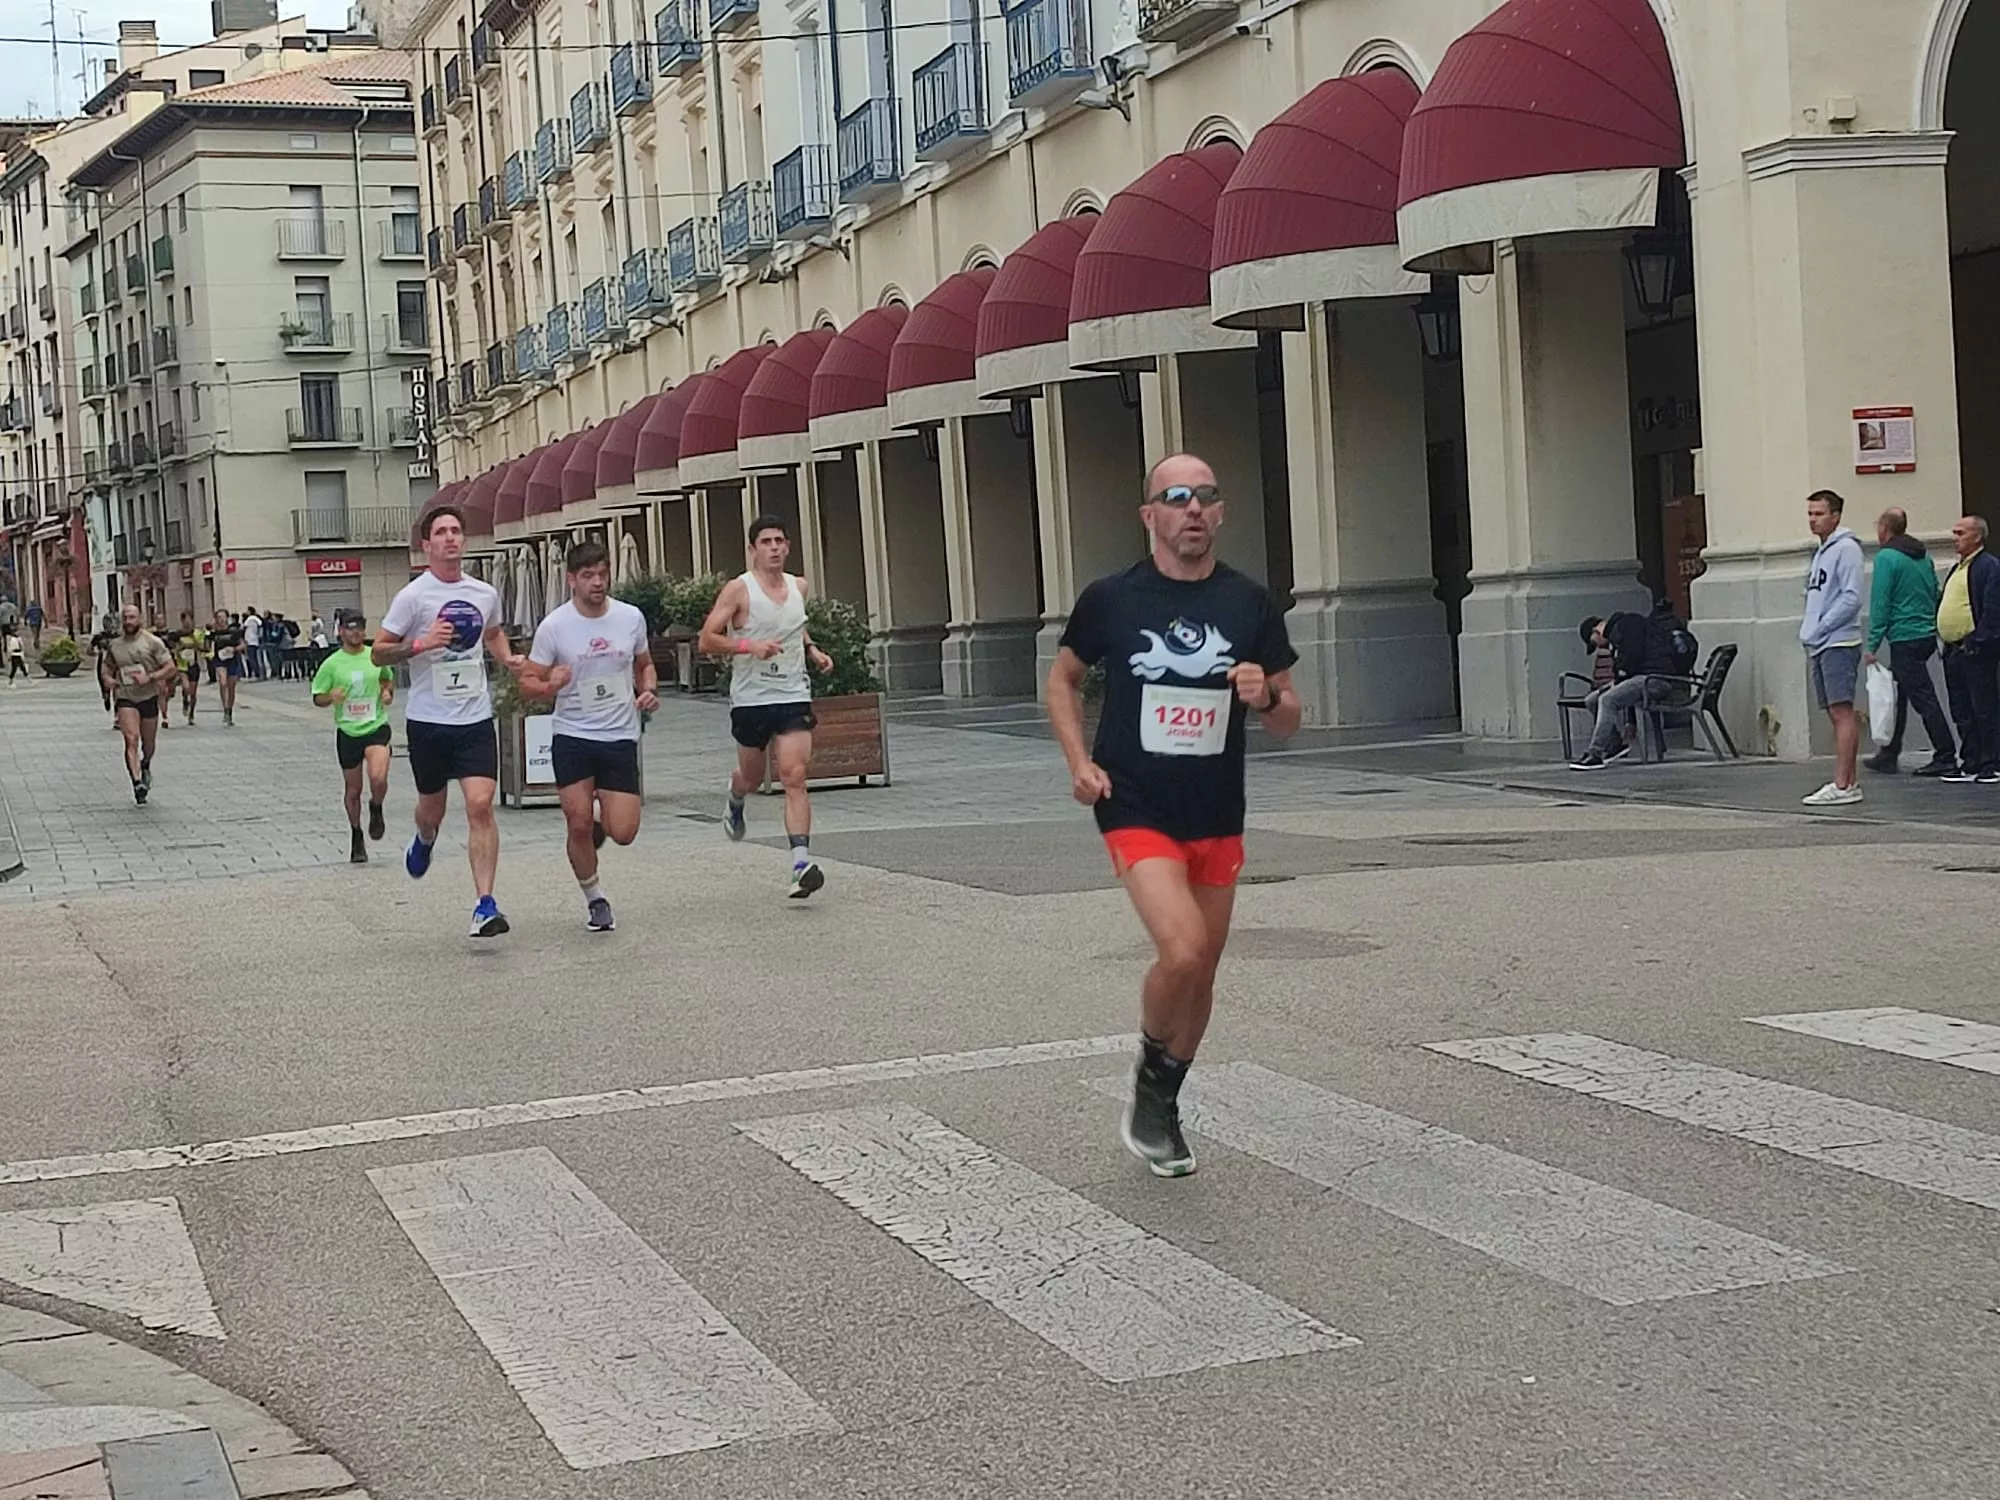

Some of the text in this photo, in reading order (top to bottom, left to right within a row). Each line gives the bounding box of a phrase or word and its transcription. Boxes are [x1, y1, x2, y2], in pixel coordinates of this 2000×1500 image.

[411, 367, 429, 460] HOSTAL
[450, 672, 460, 685] 7
[1154, 704, 1218, 729] 1201
